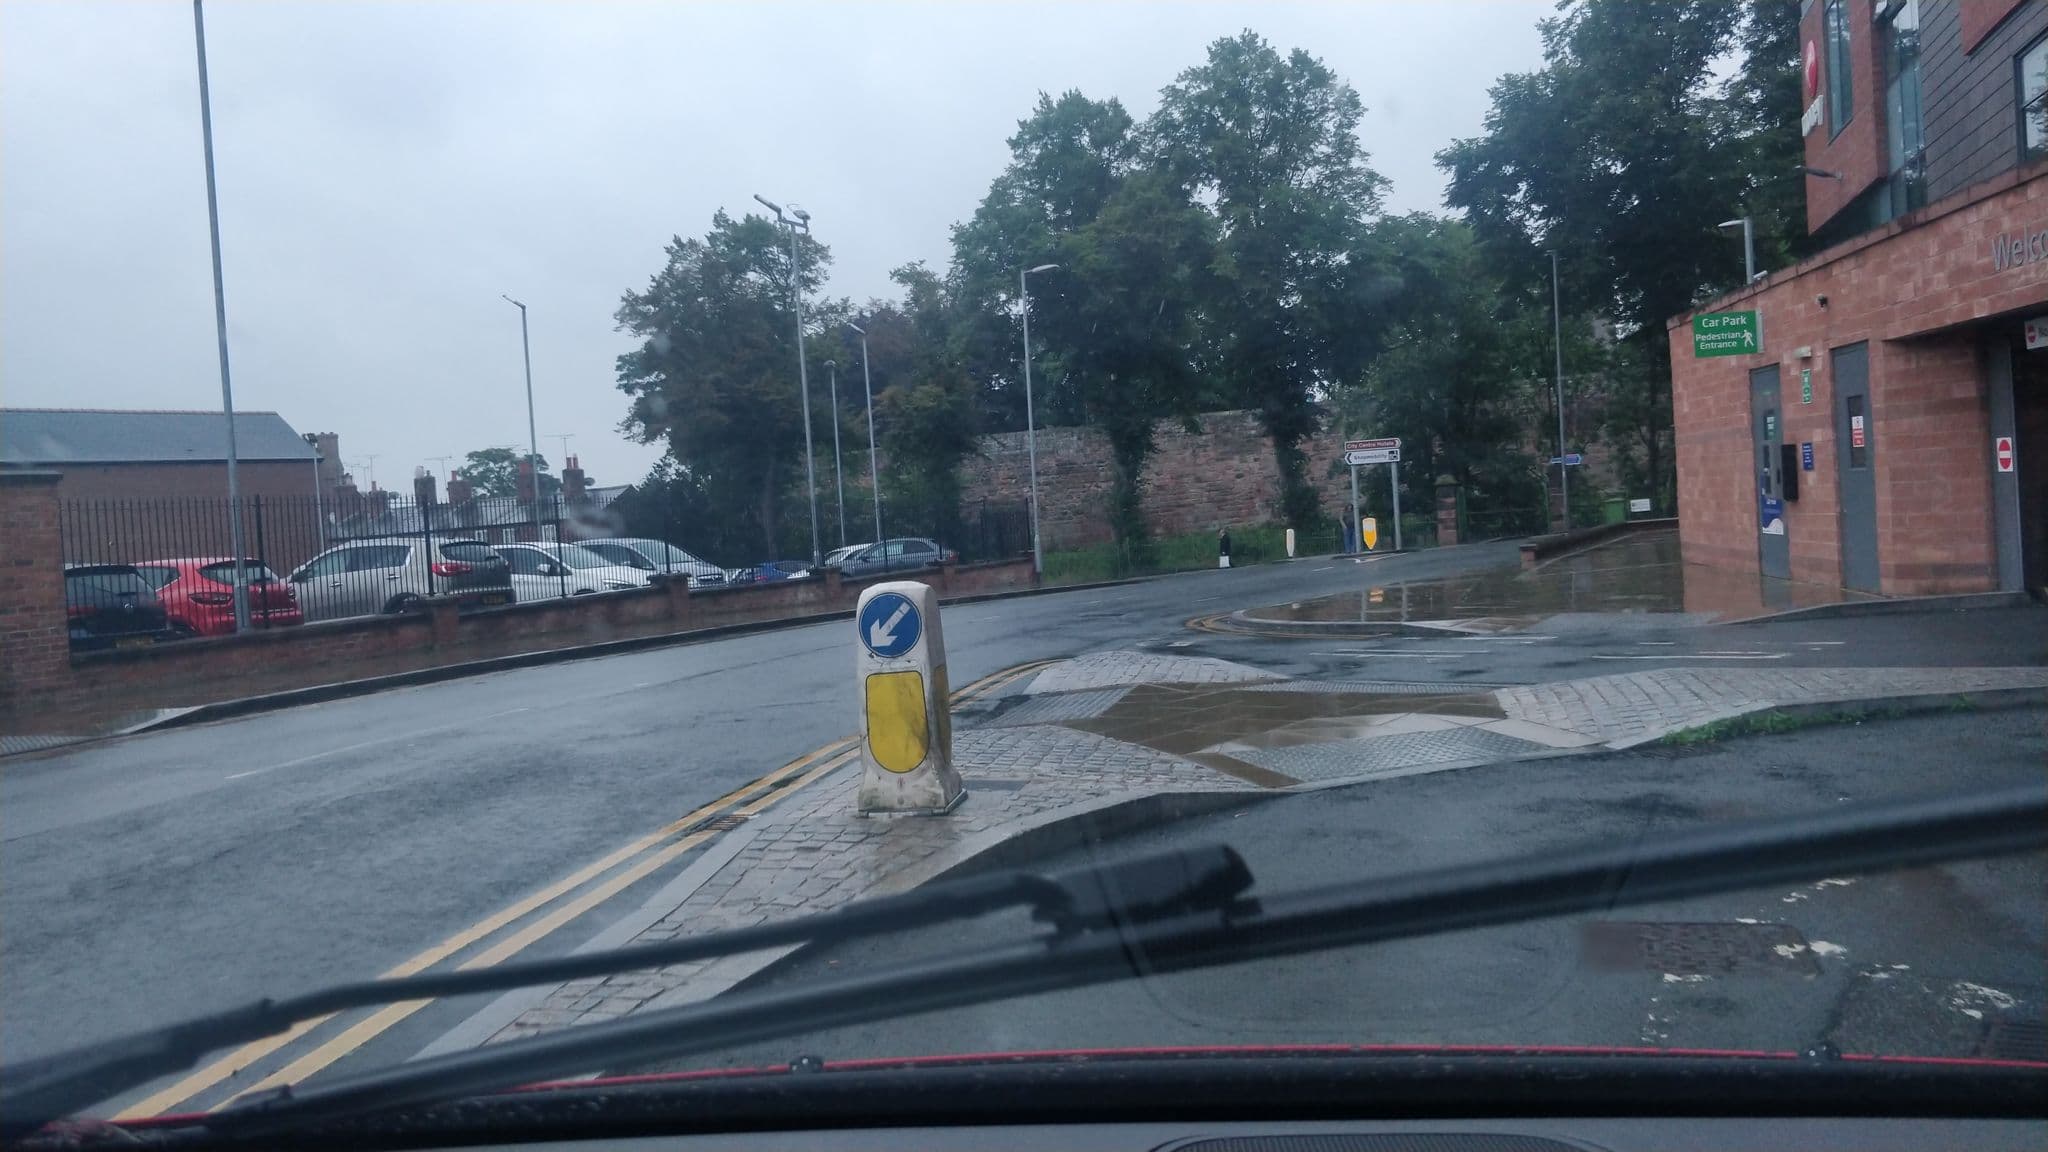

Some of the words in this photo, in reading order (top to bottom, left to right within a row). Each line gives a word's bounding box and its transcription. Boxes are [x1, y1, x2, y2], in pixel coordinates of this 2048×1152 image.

[1702, 318, 1720, 328] Car
[1722, 315, 1747, 326] Park
[1695, 332, 1741, 342] Pedestrian
[1700, 340, 1737, 350] Entrance
